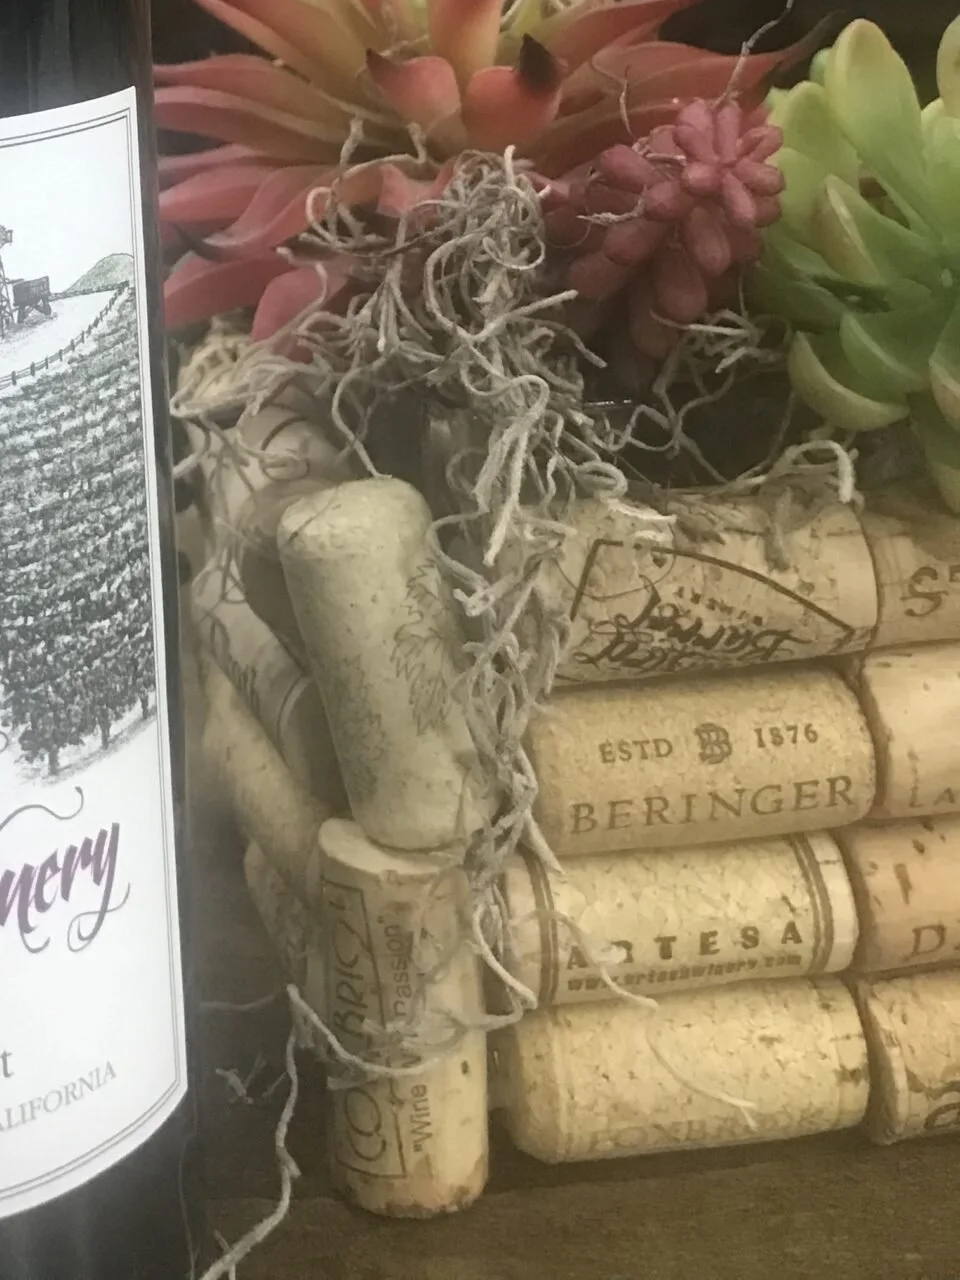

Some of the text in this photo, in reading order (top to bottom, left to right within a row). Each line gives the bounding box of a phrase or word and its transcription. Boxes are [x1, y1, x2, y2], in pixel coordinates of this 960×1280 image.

[597, 736, 674, 765] ESTD
[753, 722, 820, 750] 1876
[568, 774, 856, 835] BERINGER
